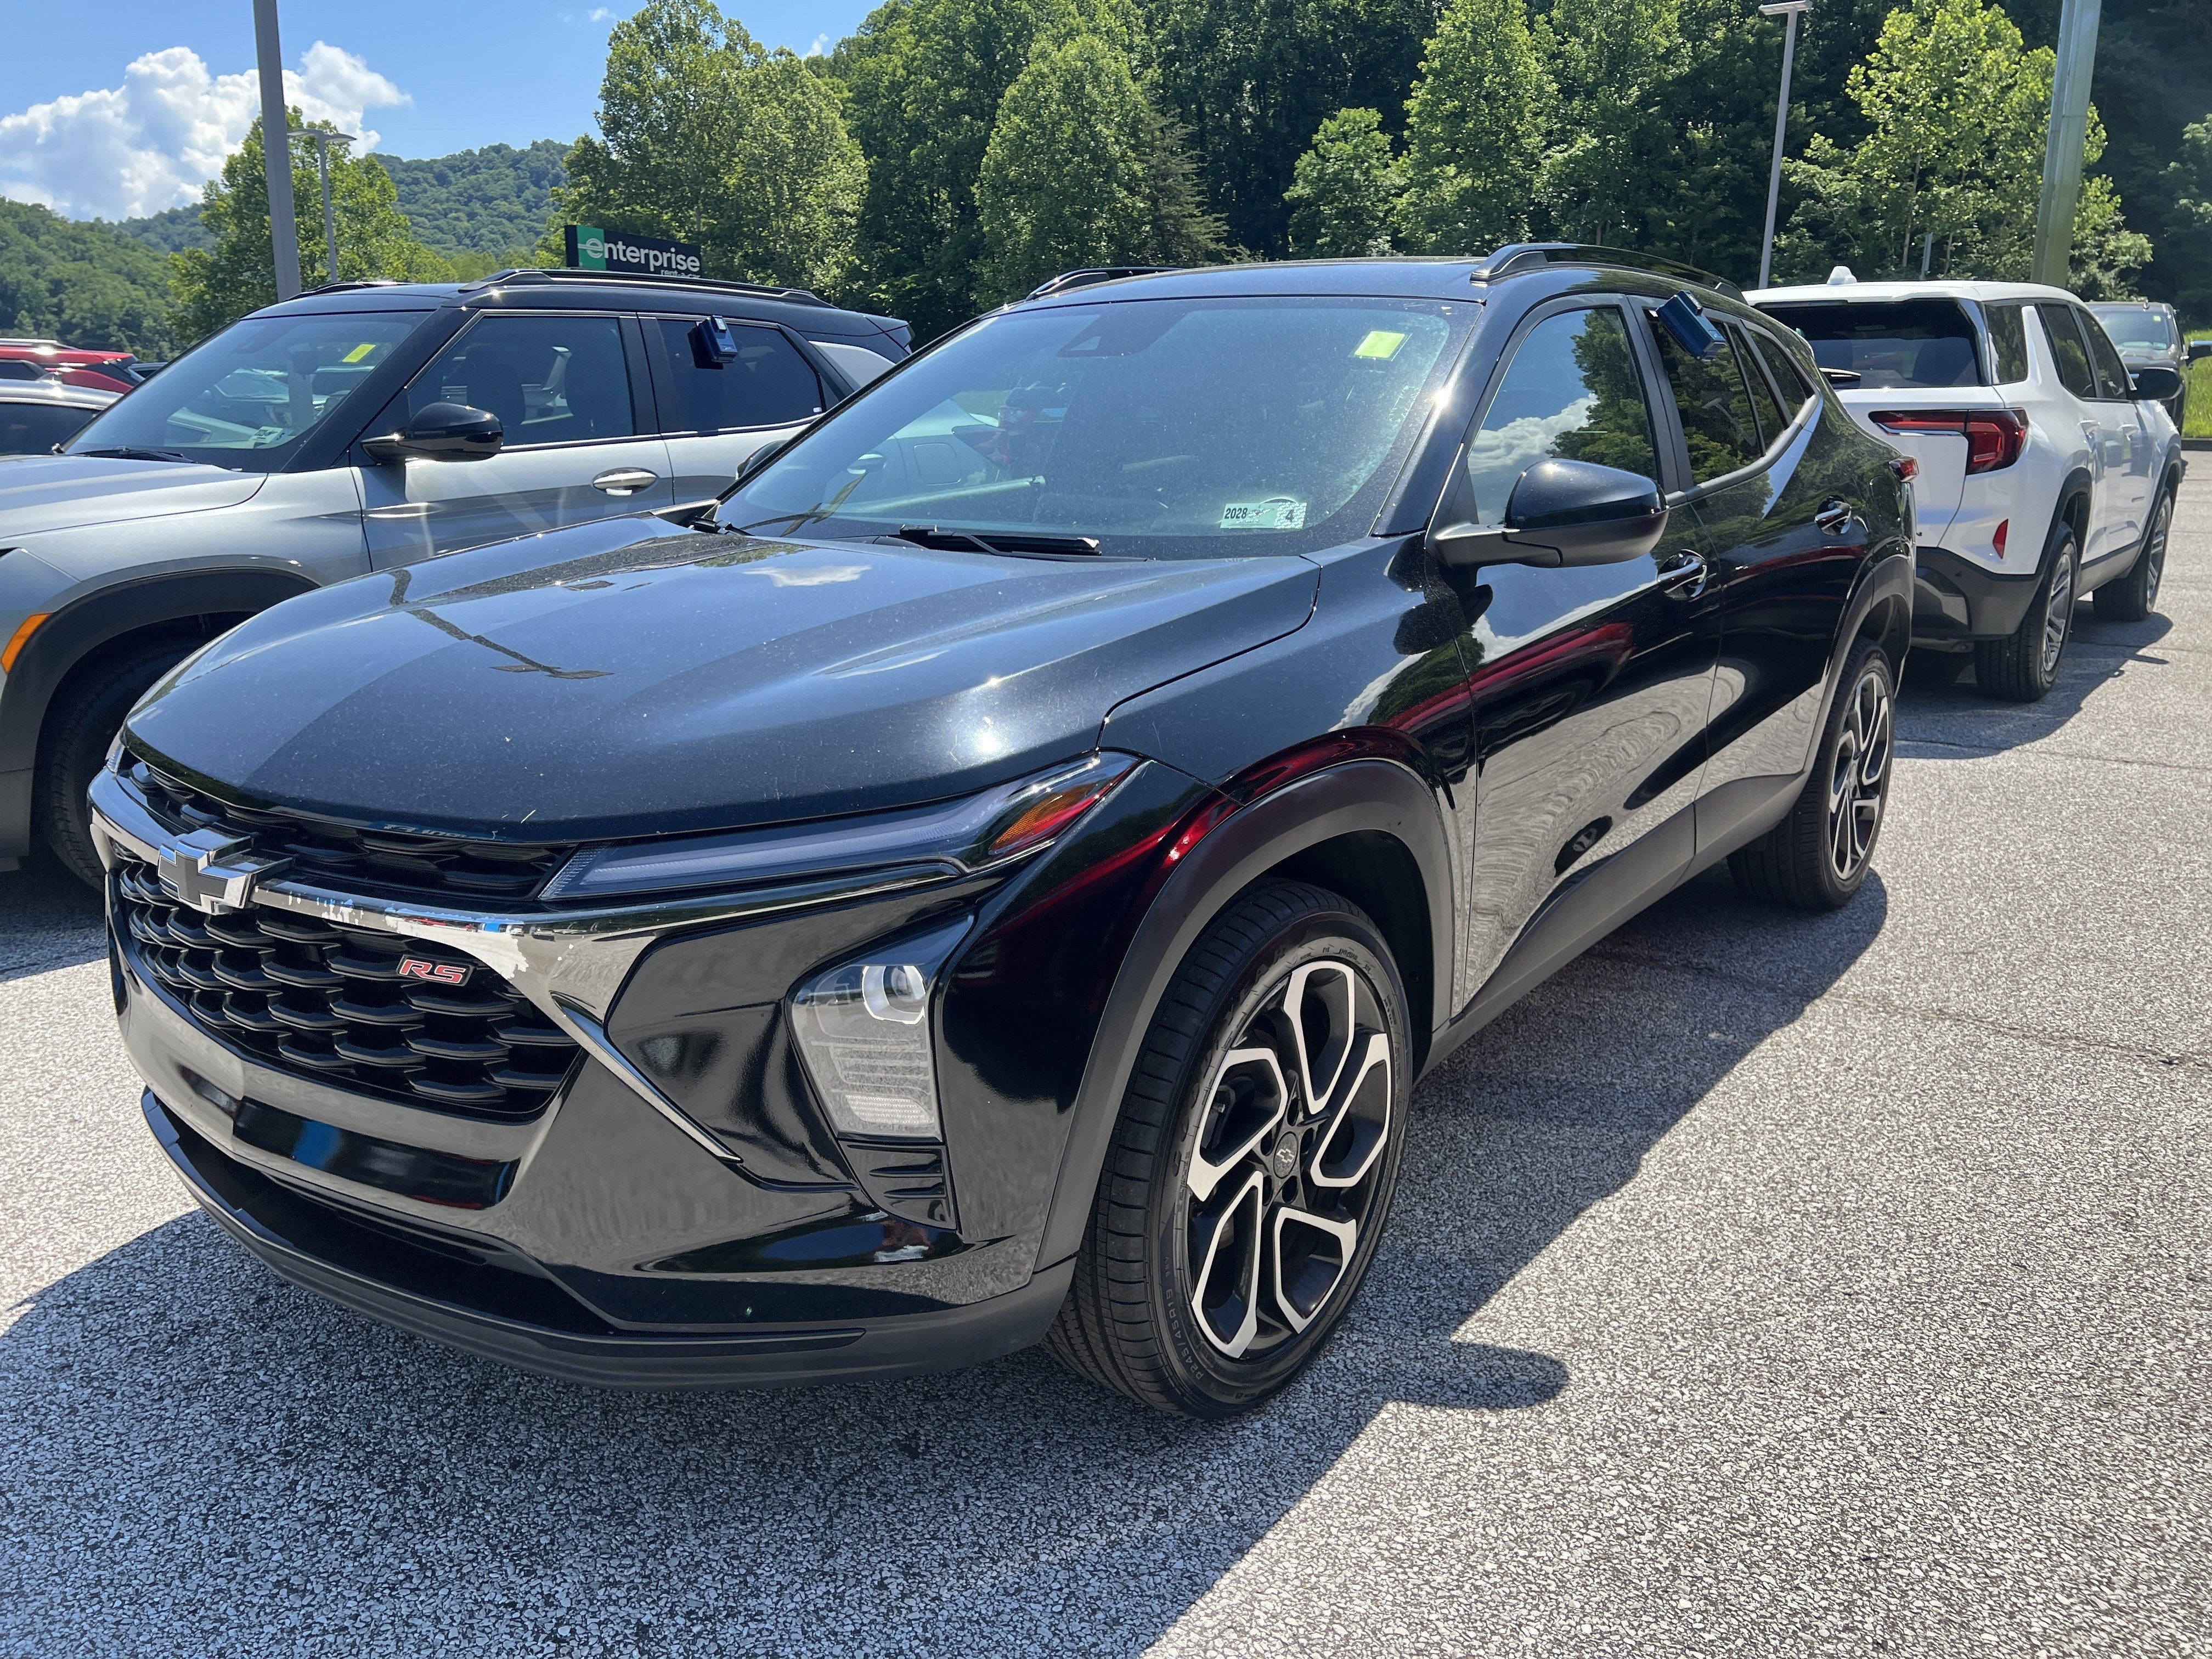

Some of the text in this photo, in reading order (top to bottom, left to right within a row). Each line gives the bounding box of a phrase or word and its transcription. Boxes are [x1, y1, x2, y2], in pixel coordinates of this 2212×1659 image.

[578, 238, 701, 272] enterprise
[1224, 507, 1295, 522] 2028 4
[399, 959, 466, 984] RS
